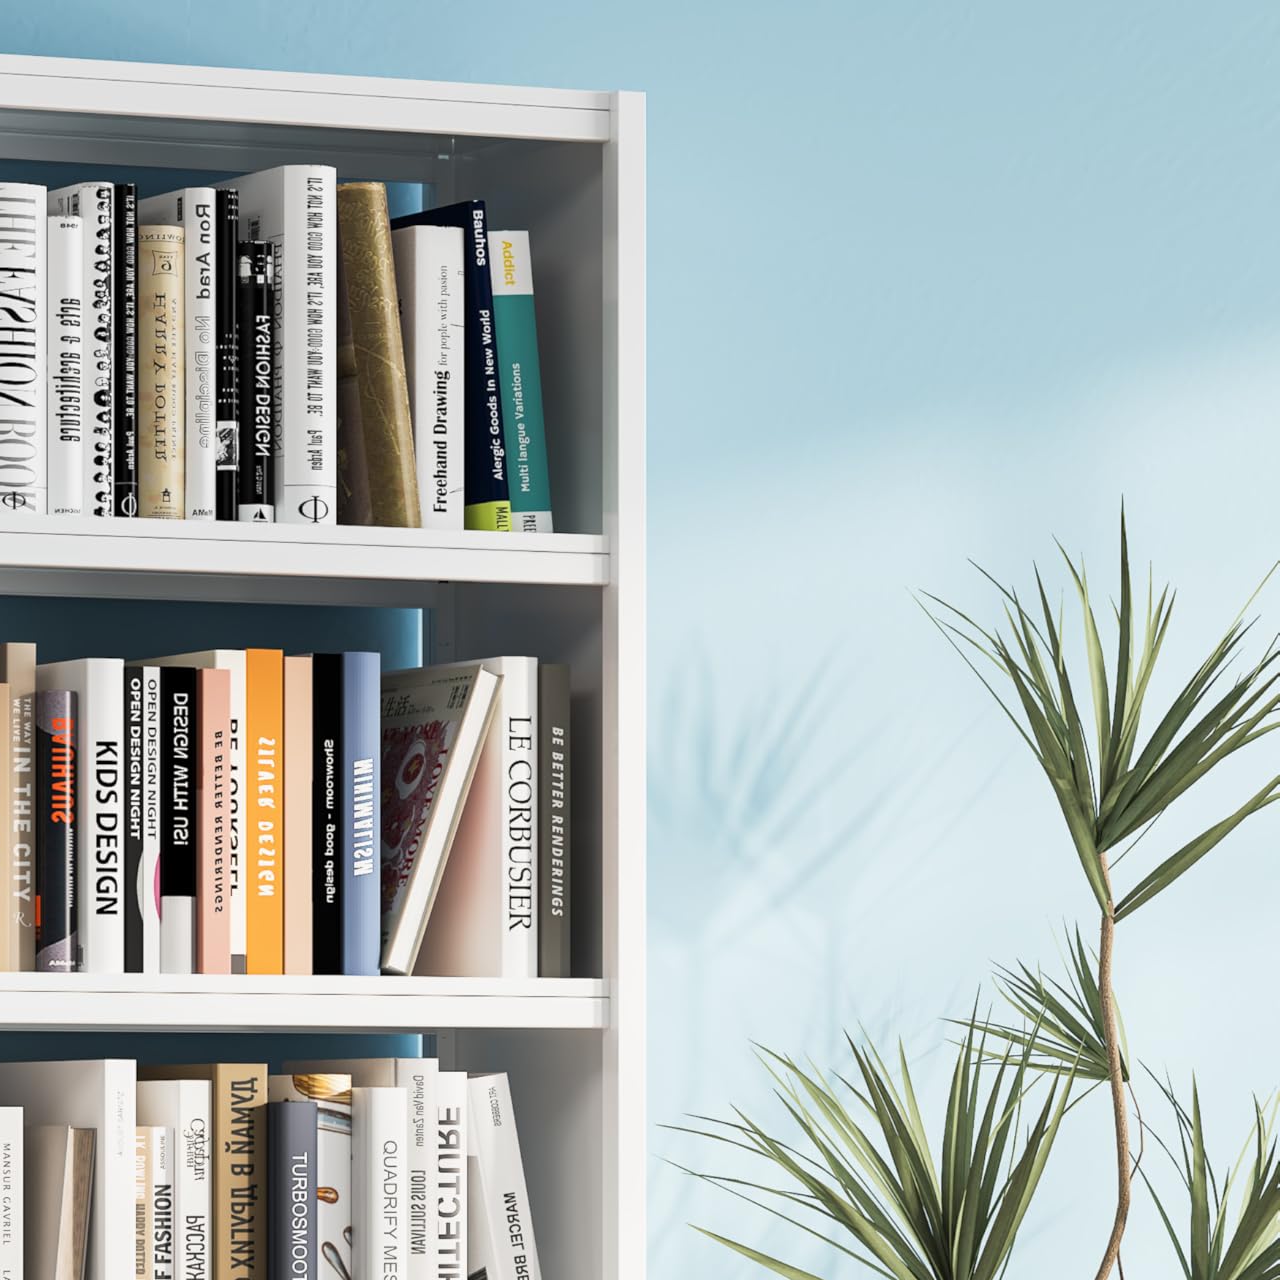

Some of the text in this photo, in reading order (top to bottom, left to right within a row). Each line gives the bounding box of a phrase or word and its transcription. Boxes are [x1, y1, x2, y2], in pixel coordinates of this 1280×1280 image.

[472, 209, 487, 266] Bauhos
[501, 241, 516, 286] Addict
[433, 265, 450, 513] Freehand Drawing for pople with pasion
[479, 310, 504, 481] Alergic Goods In New World
[511, 363, 531, 492] Multi langue Variations
[13, 748, 30, 902] IN THE CITY
[95, 741, 118, 915] KIDS DESIGN
[130, 679, 141, 839] OPEN DESIGN NIGHT
[509, 717, 532, 931] LE CORBUSIER
[551, 727, 563, 917] BE BETTER RENDERINGS
[154, 1185, 172, 1263] FASHION
[383, 1140, 397, 1240] QUADRIFY
